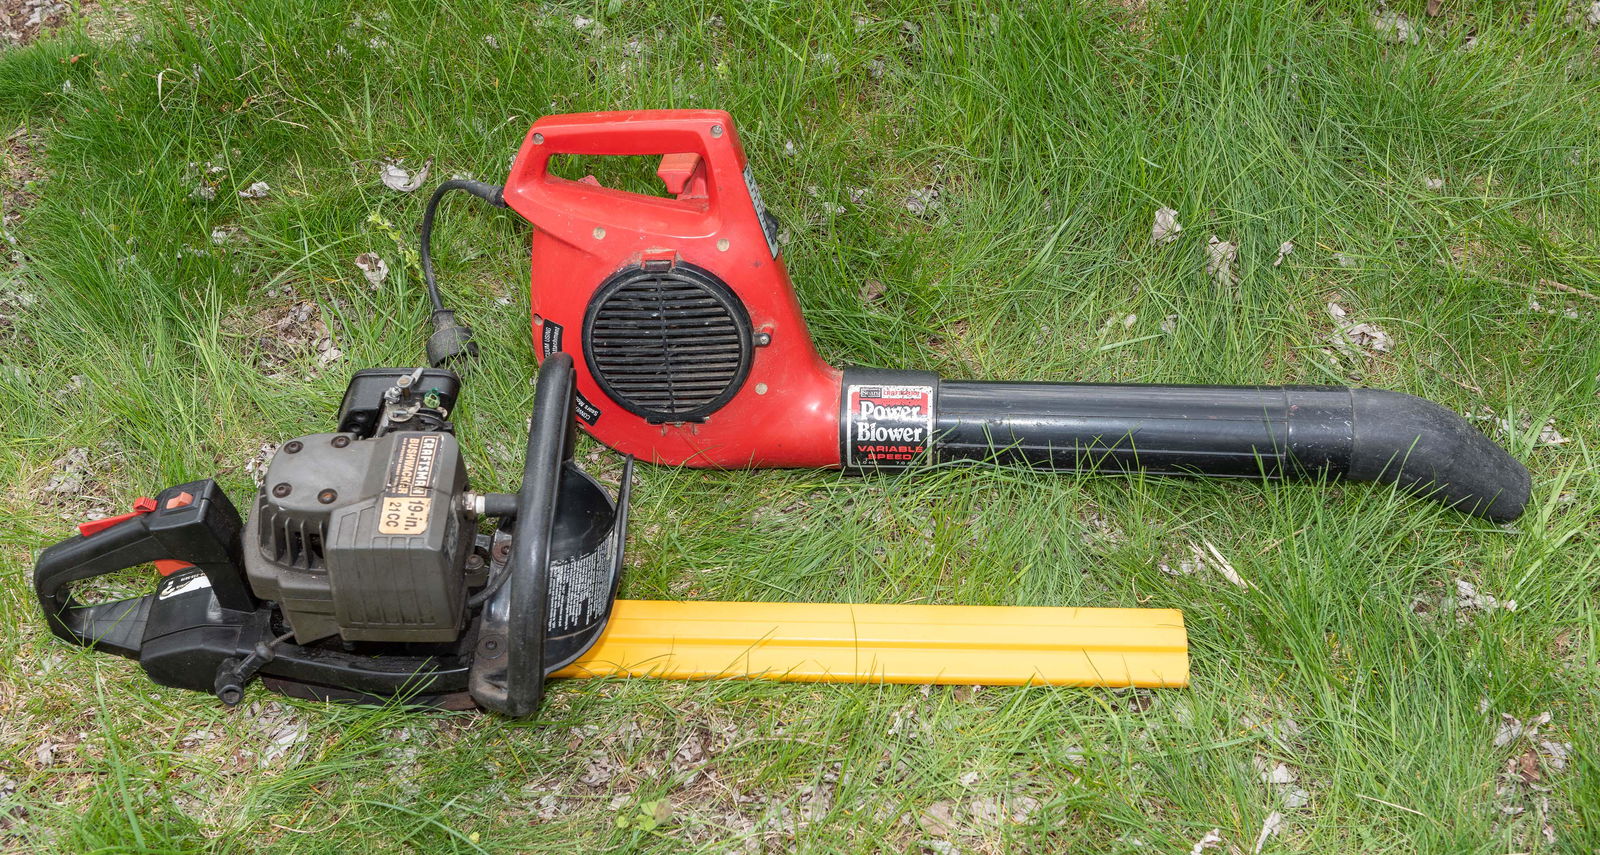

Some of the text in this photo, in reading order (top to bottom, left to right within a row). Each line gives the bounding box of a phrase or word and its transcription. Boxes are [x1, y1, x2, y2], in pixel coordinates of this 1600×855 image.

[552, 326, 560, 353] ttachment
[860, 401, 921, 420] Power
[857, 422, 922, 442] Blower
[857, 445, 923, 453] VARIABLE
[412, 438, 436, 494] CRAFTSMAN
[385, 502, 402, 528] 21CC
[404, 500, 424, 531] 19-in.
